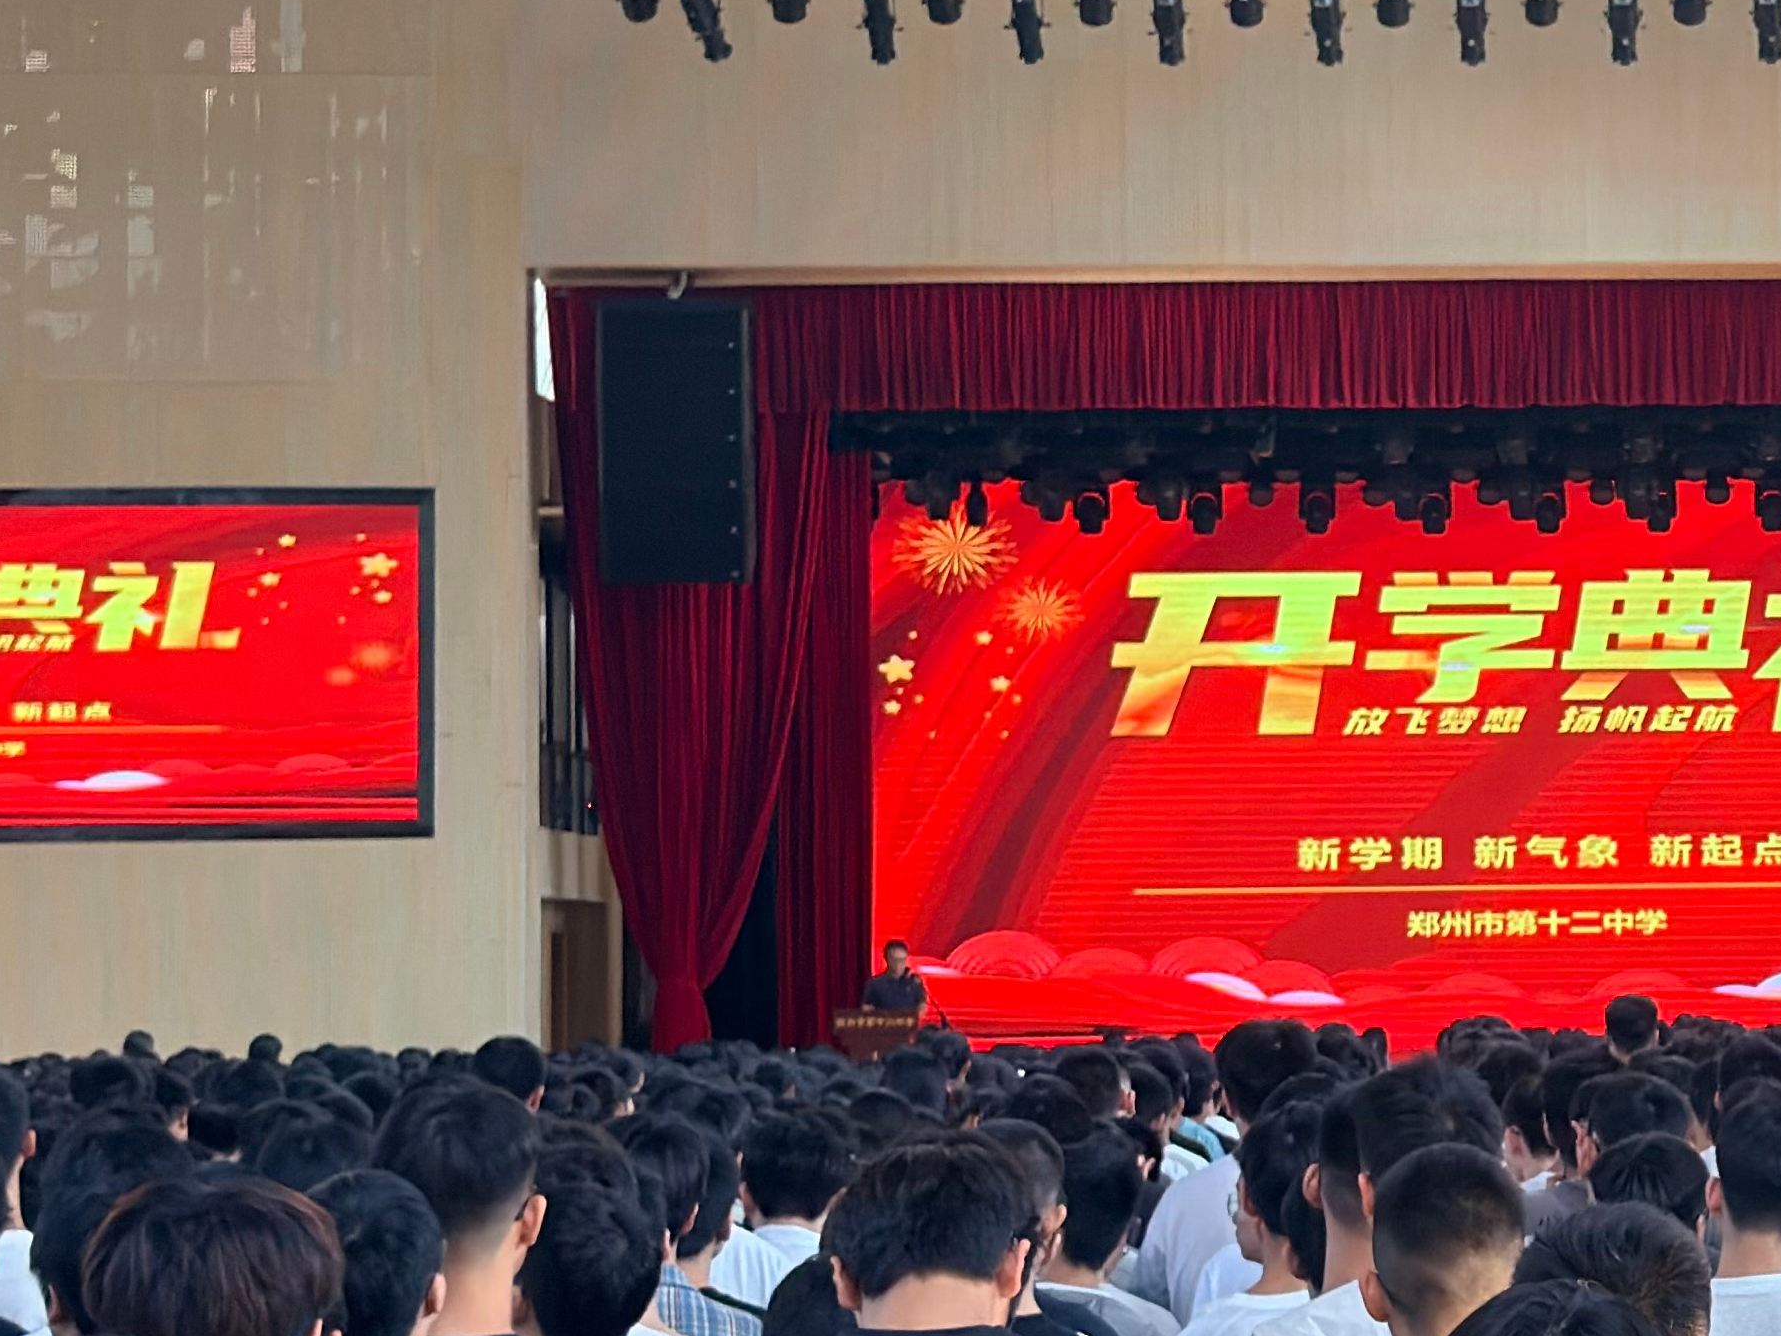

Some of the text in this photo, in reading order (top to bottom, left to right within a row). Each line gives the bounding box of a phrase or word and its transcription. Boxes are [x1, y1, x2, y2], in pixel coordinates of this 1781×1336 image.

[12, 701, 112, 723] 新起点
[1342, 704, 1740, 736] 放飞梦想 扬帆起航
[1297, 836, 1443, 871] 新学期
[1473, 834, 1619, 870] 新气象
[1405, 909, 1669, 938] 郑州市第十二中学
